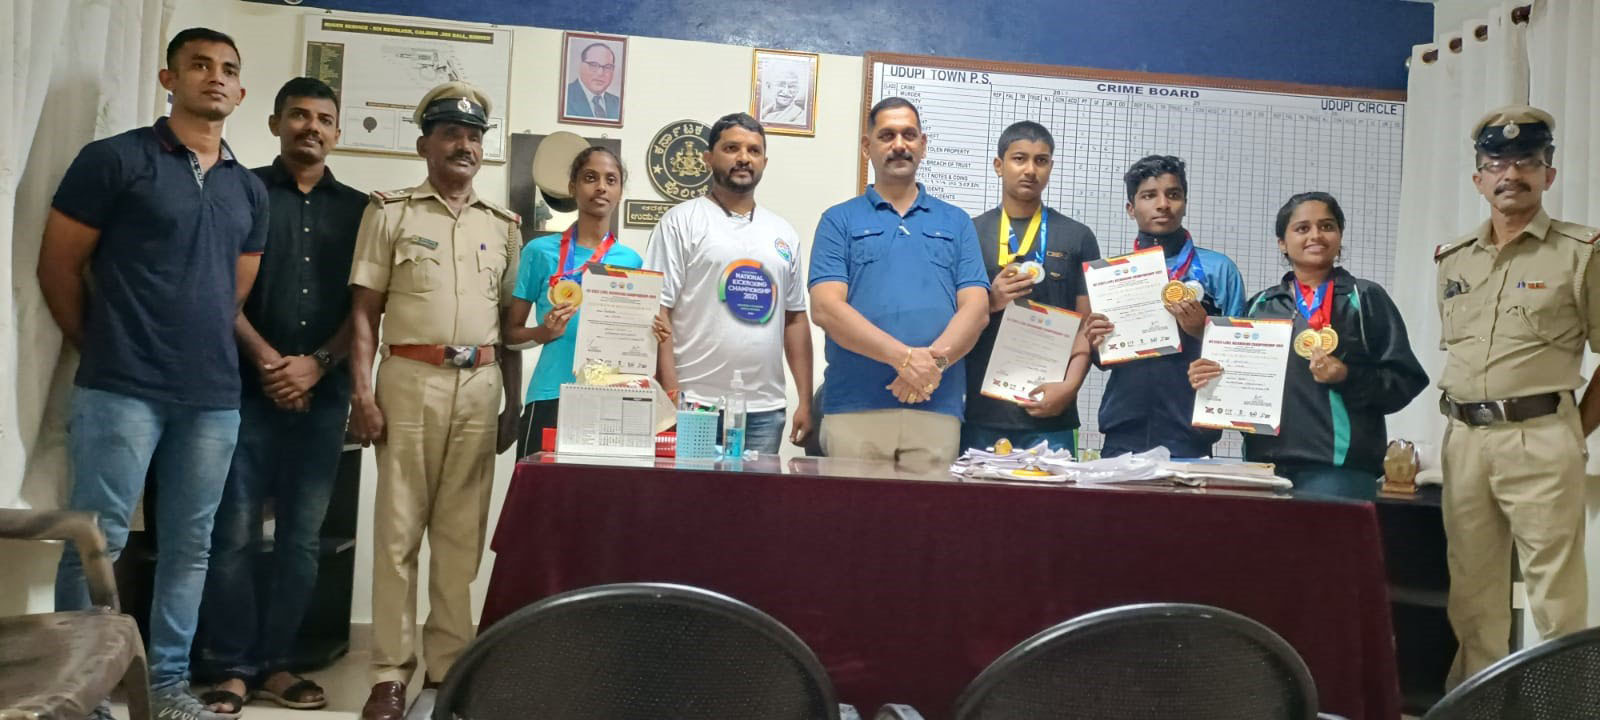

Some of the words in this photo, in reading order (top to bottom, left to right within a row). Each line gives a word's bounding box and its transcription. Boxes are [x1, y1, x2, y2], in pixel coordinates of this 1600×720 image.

[890, 65, 926, 80] UDUPI
[931, 69, 966, 83] TOWN
[970, 72, 992, 85] P.S.
[1097, 83, 1144, 95] CRIME
[1149, 87, 1200, 99] BOARD
[1321, 99, 1353, 112] UDUPI
[1357, 102, 1398, 115] CIRCLE
[735, 272, 764, 281] NATIONAL
